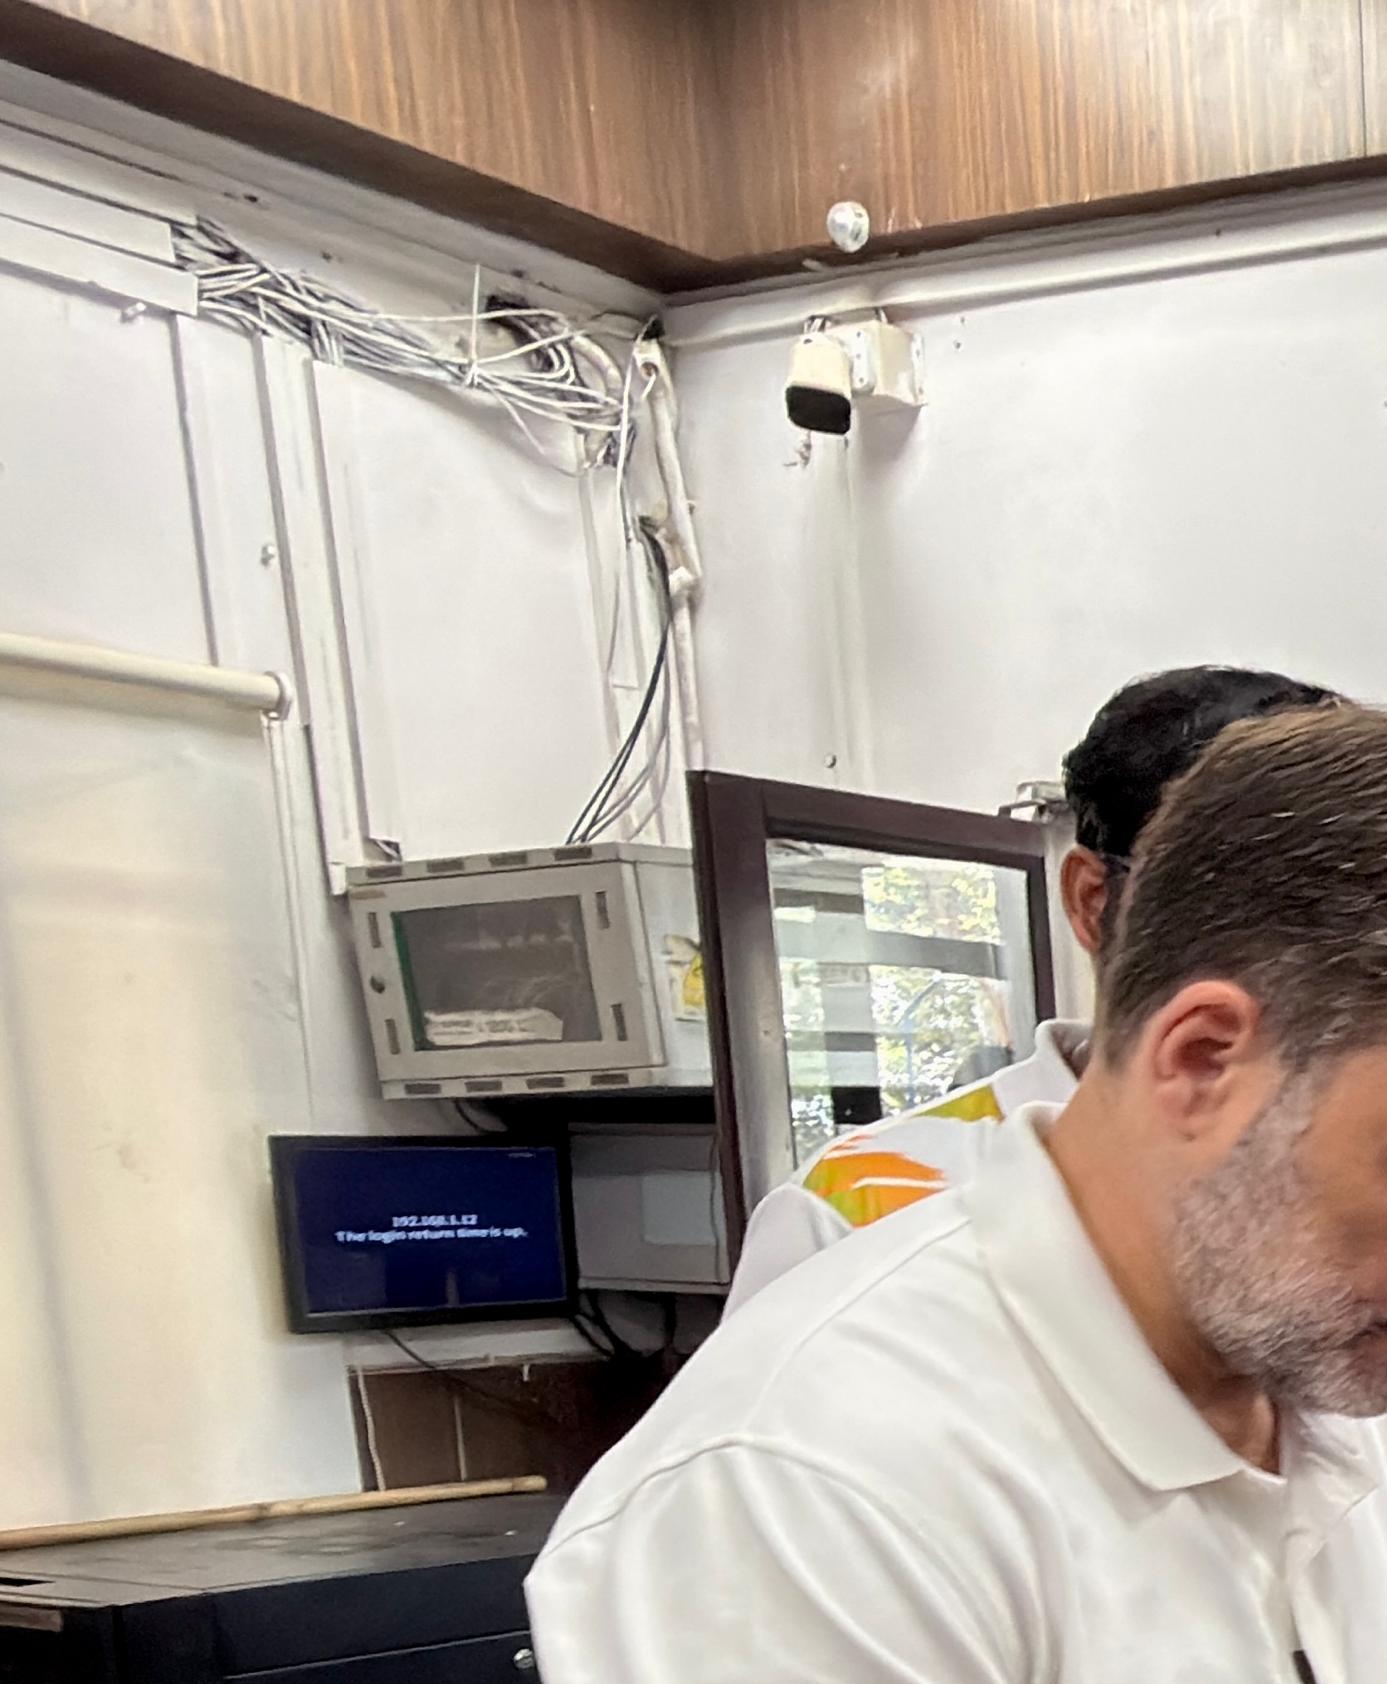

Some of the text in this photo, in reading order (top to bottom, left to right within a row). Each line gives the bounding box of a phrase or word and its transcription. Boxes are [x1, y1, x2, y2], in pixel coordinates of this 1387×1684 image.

[335, 1231, 366, 1242] The
[368, 1230, 406, 1244] login
[408, 1229, 455, 1240] return
